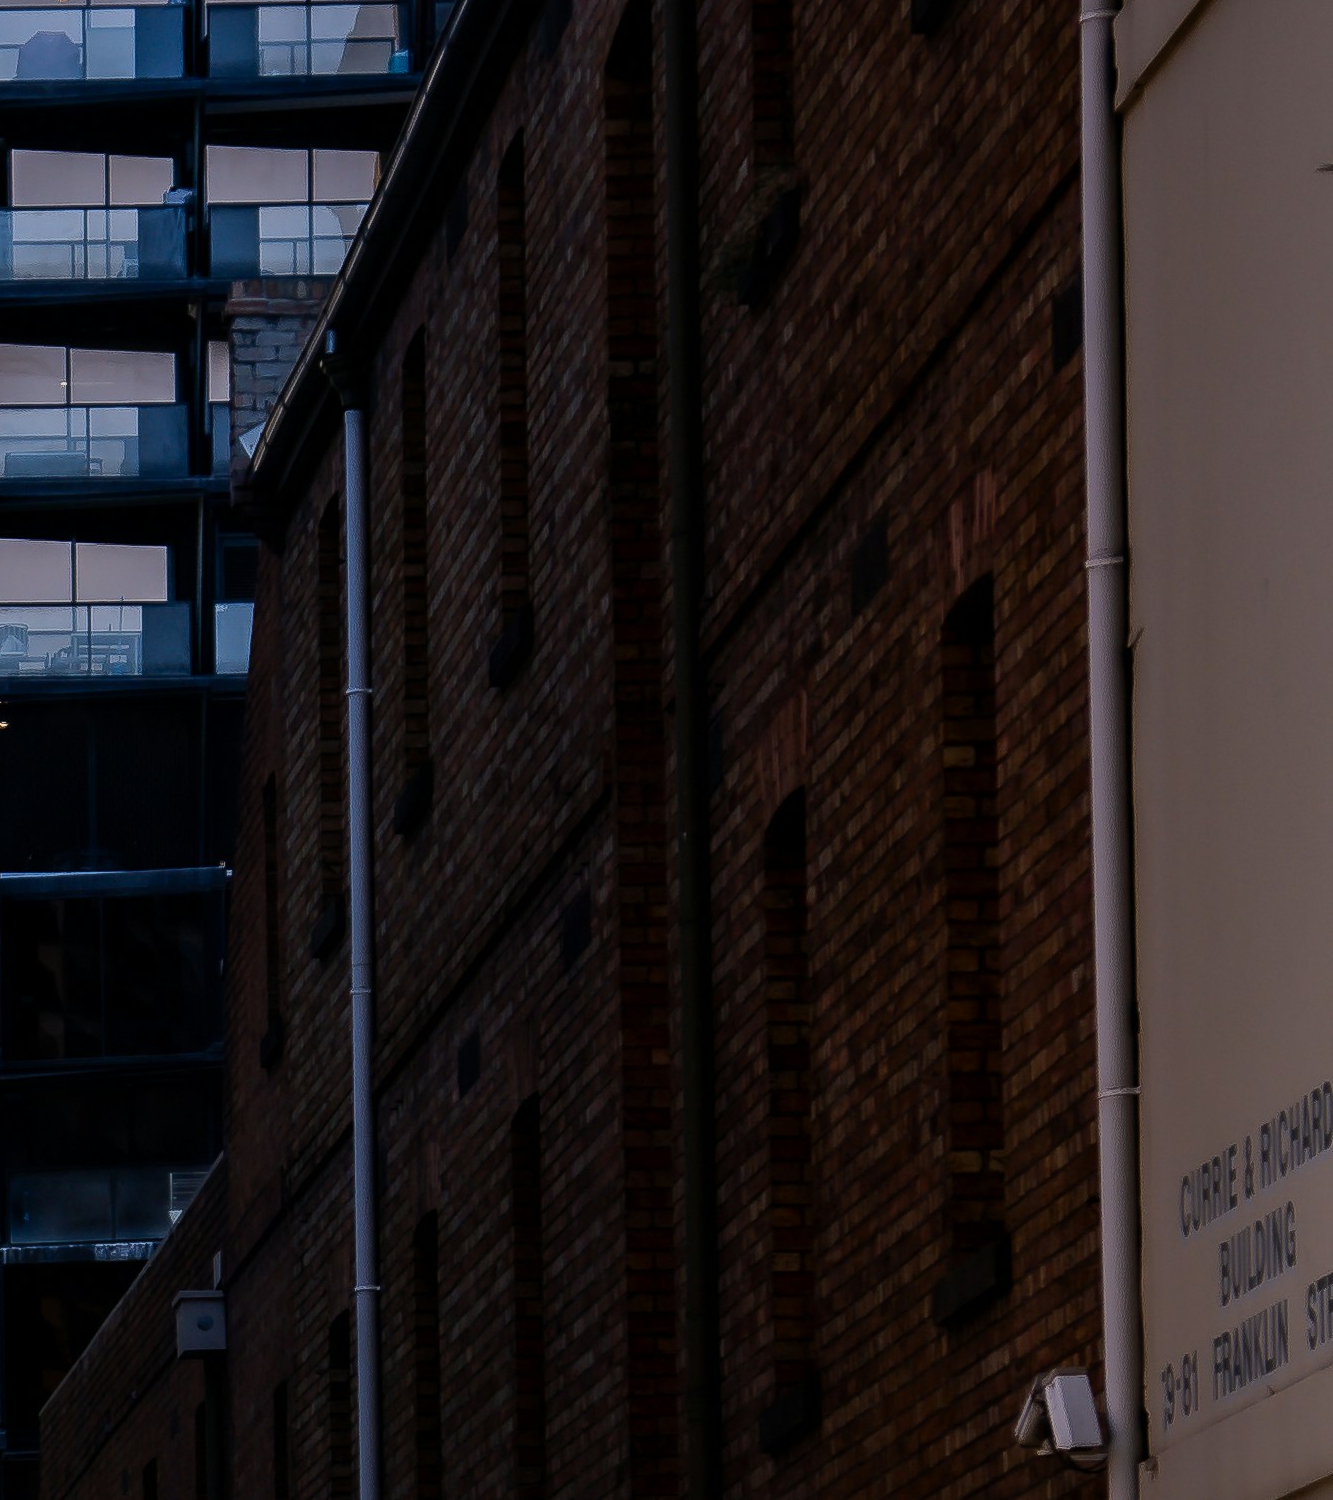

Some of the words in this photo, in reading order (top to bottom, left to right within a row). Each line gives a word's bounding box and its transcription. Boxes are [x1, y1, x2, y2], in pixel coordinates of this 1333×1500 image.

[1179, 1143, 1238, 1237] CURRIE
[1244, 1135, 1255, 1199] &
[1219, 1200, 1296, 1306] BUILDING
[1214, 1299, 1289, 1400] FRANKLIN
